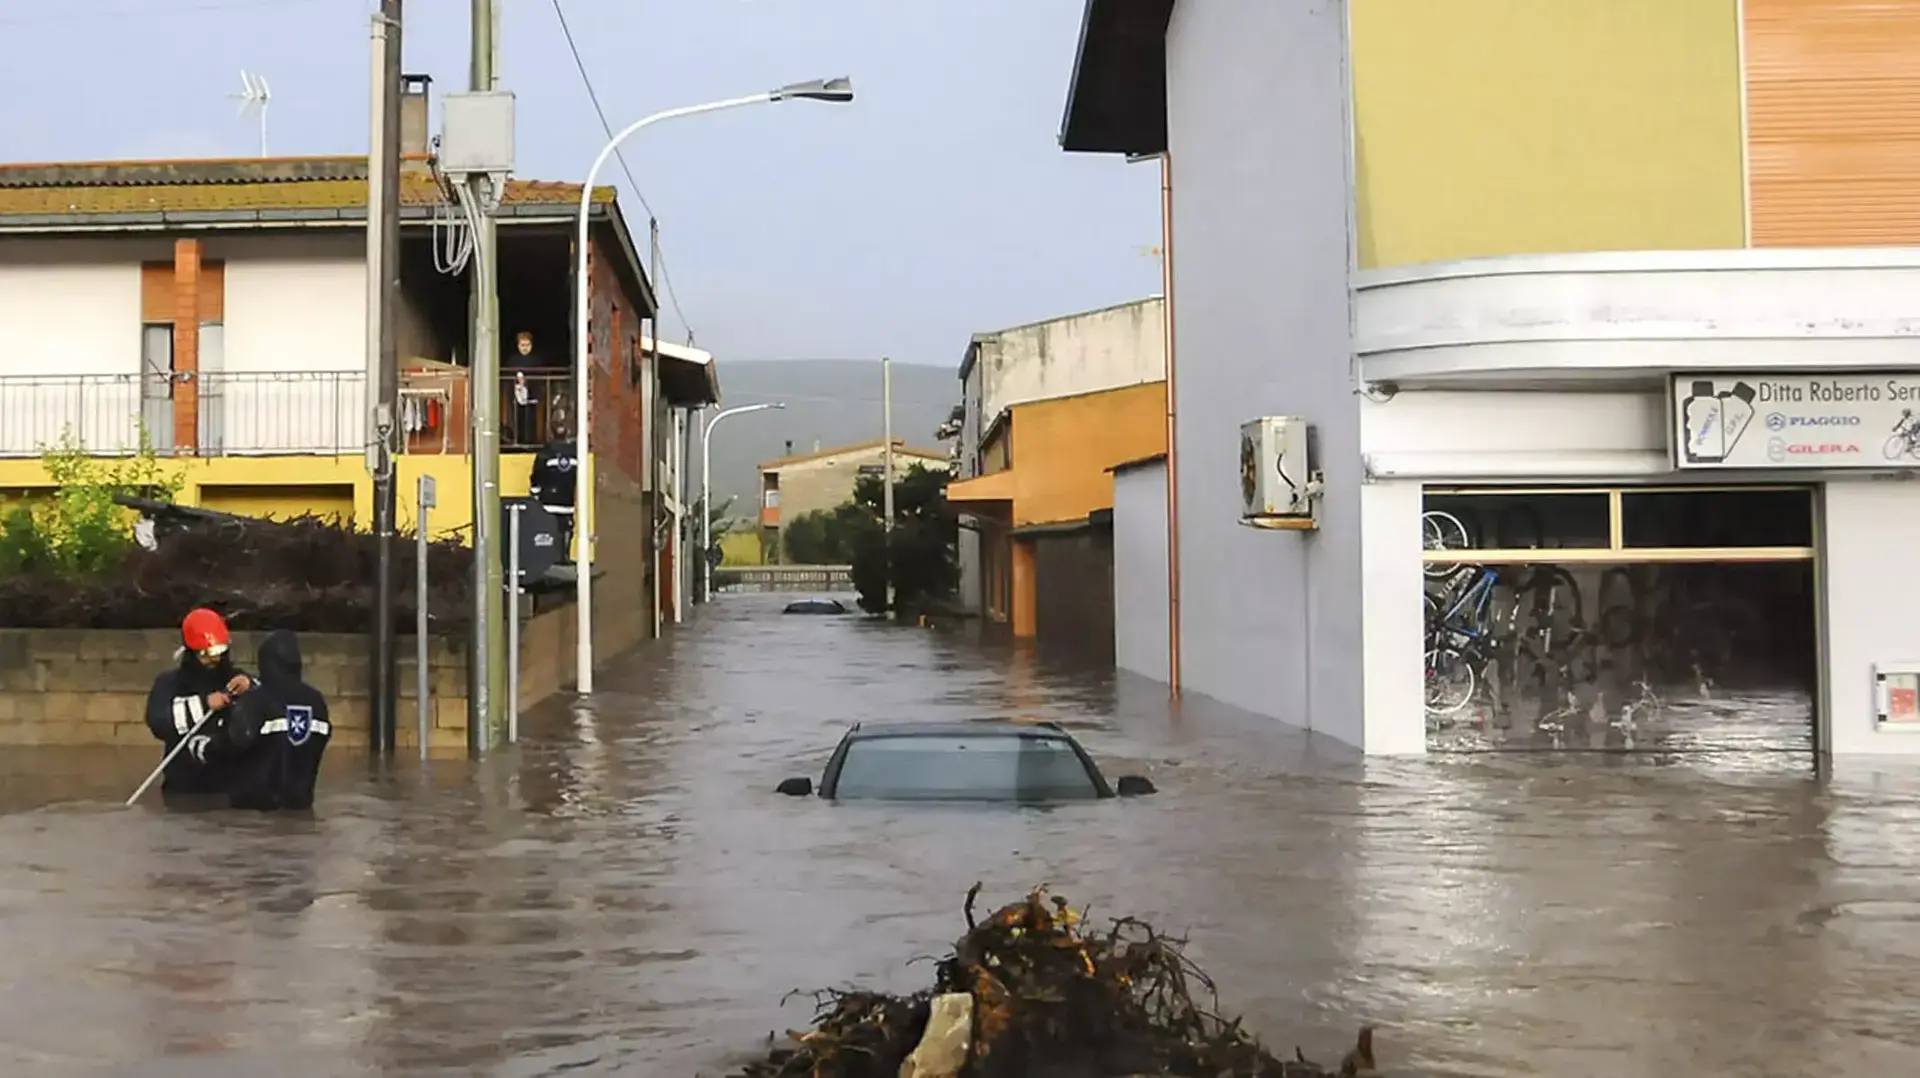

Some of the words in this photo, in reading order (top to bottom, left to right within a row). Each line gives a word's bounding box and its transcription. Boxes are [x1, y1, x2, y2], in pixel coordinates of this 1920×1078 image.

[1759, 381, 1803, 402] Ditta
[1809, 380, 1881, 402] Roberto
[1789, 415, 1860, 427] PIAGGIO
[1786, 443, 1860, 455] GILERA
